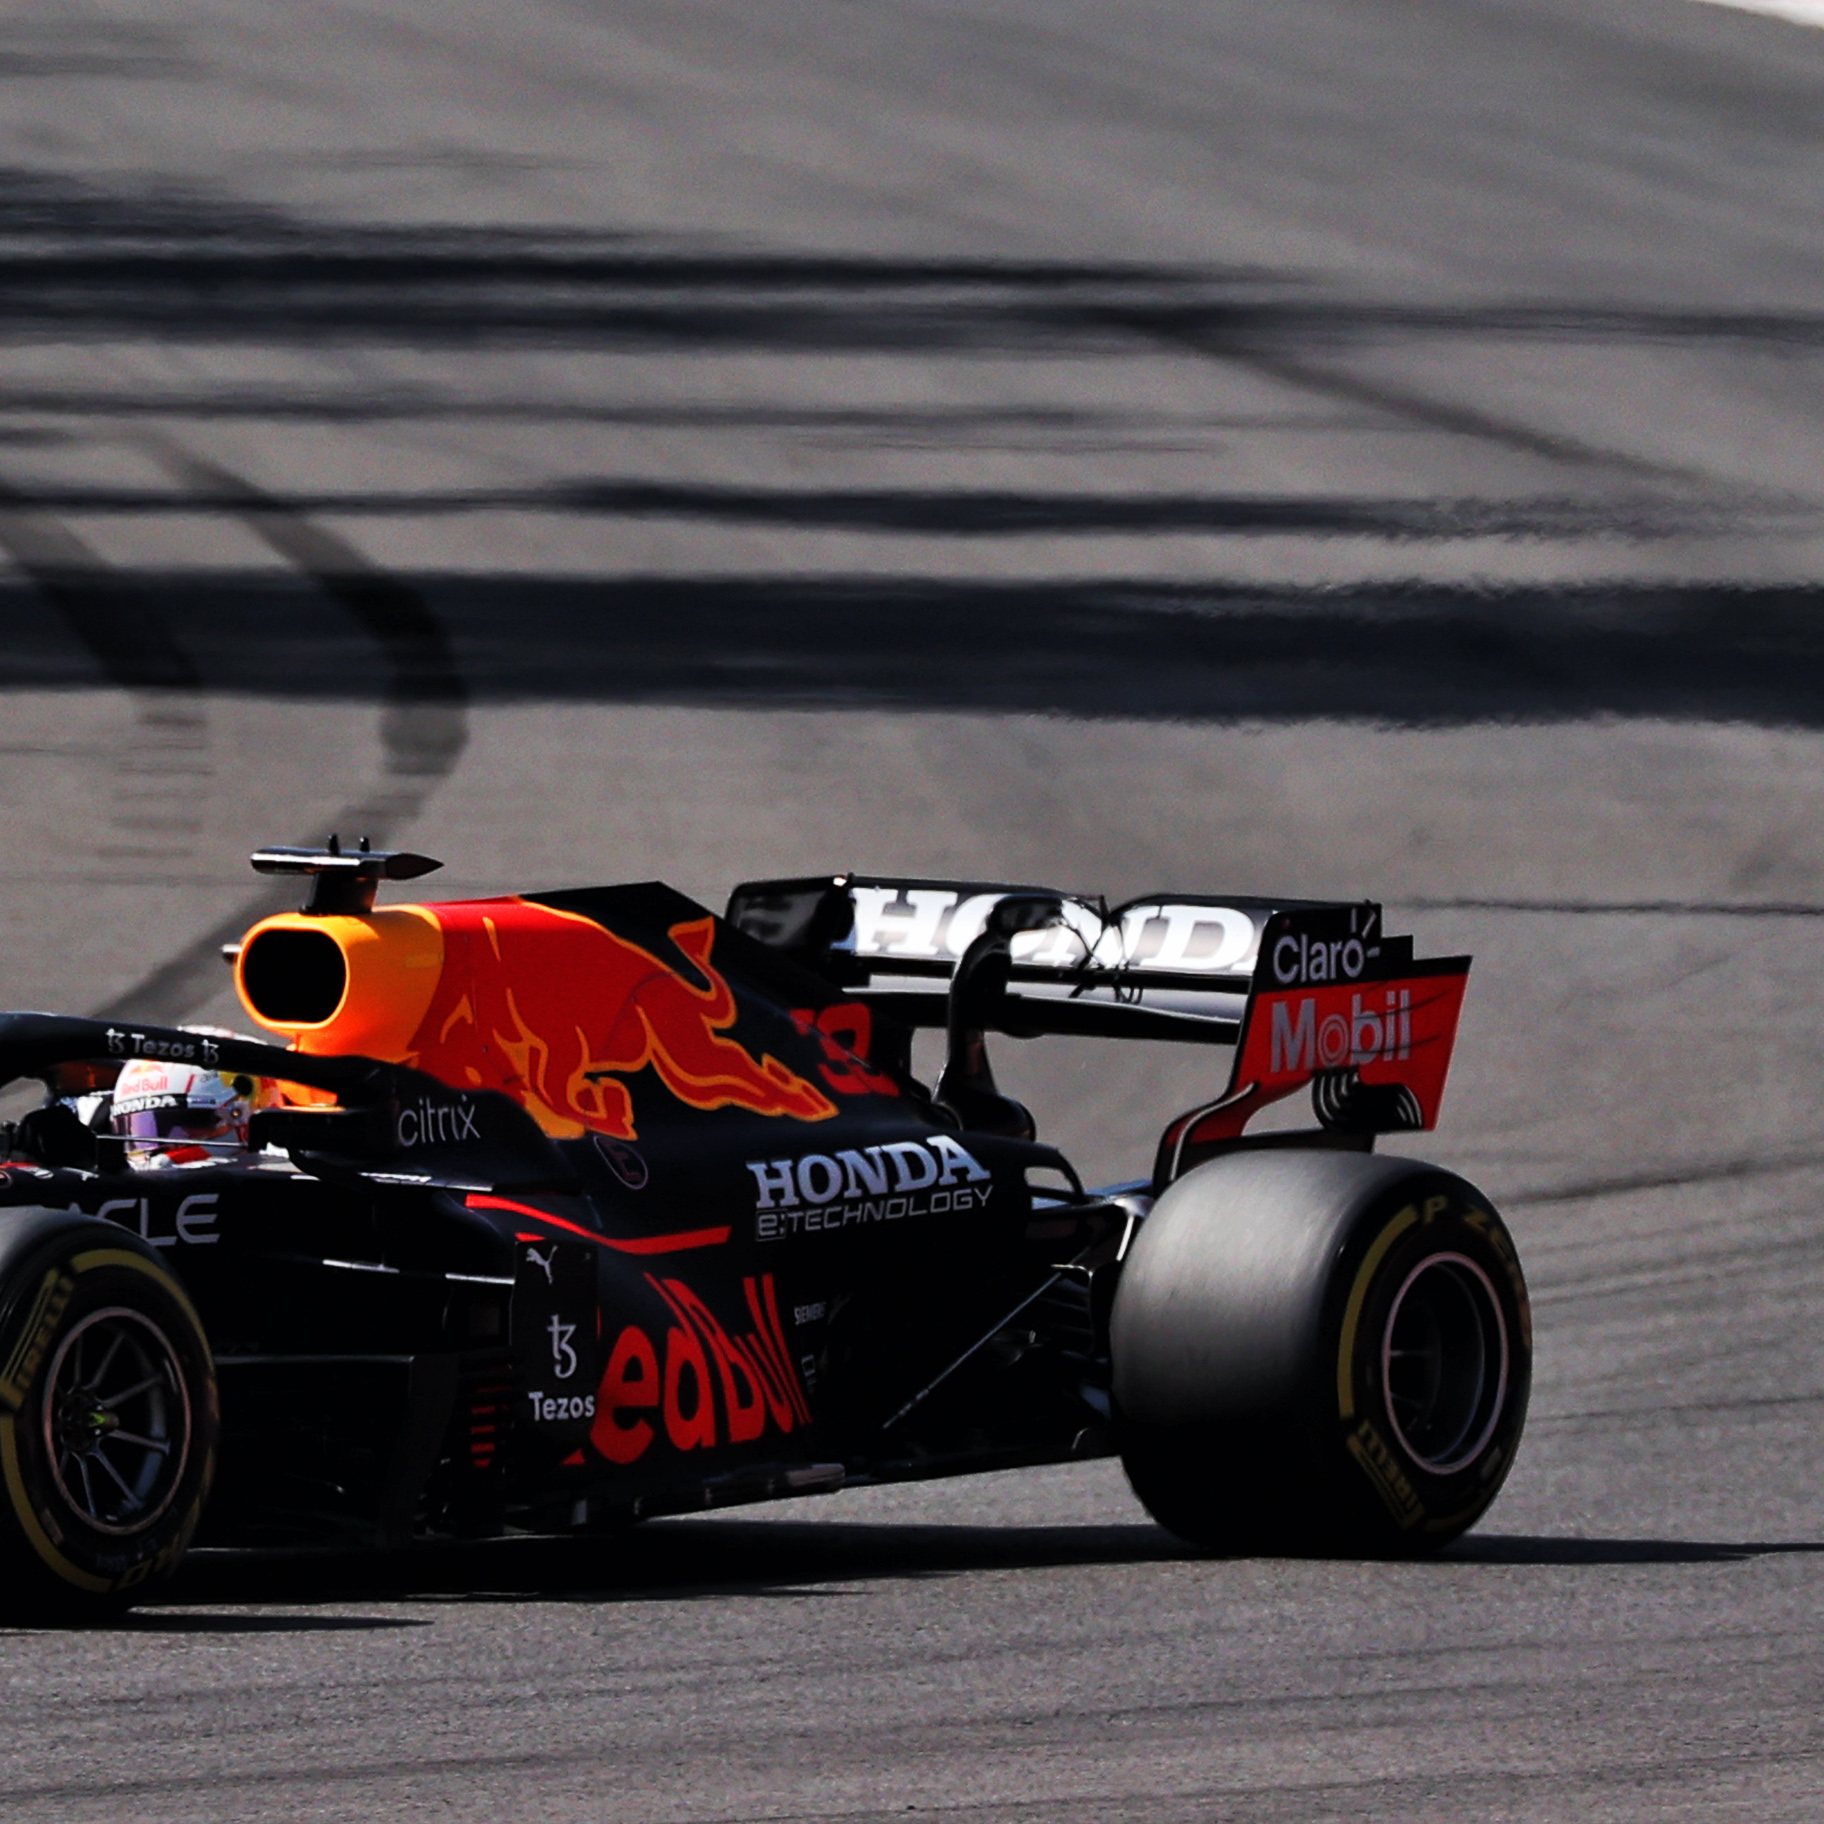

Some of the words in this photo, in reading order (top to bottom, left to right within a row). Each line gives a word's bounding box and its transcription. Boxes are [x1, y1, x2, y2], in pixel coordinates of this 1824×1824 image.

[847, 885, 1262, 977] HOND
[1272, 933, 1366, 984] Claro
[130, 1033, 196, 1060] Tezos
[1270, 988, 1413, 1073] Mobil
[112, 1094, 179, 1117] HONDA
[141, 1076, 169, 1092] Bull
[398, 1092, 480, 1147] citrix
[746, 1133, 992, 1210] HONDA
[528, 1390, 596, 1421] Tezos
